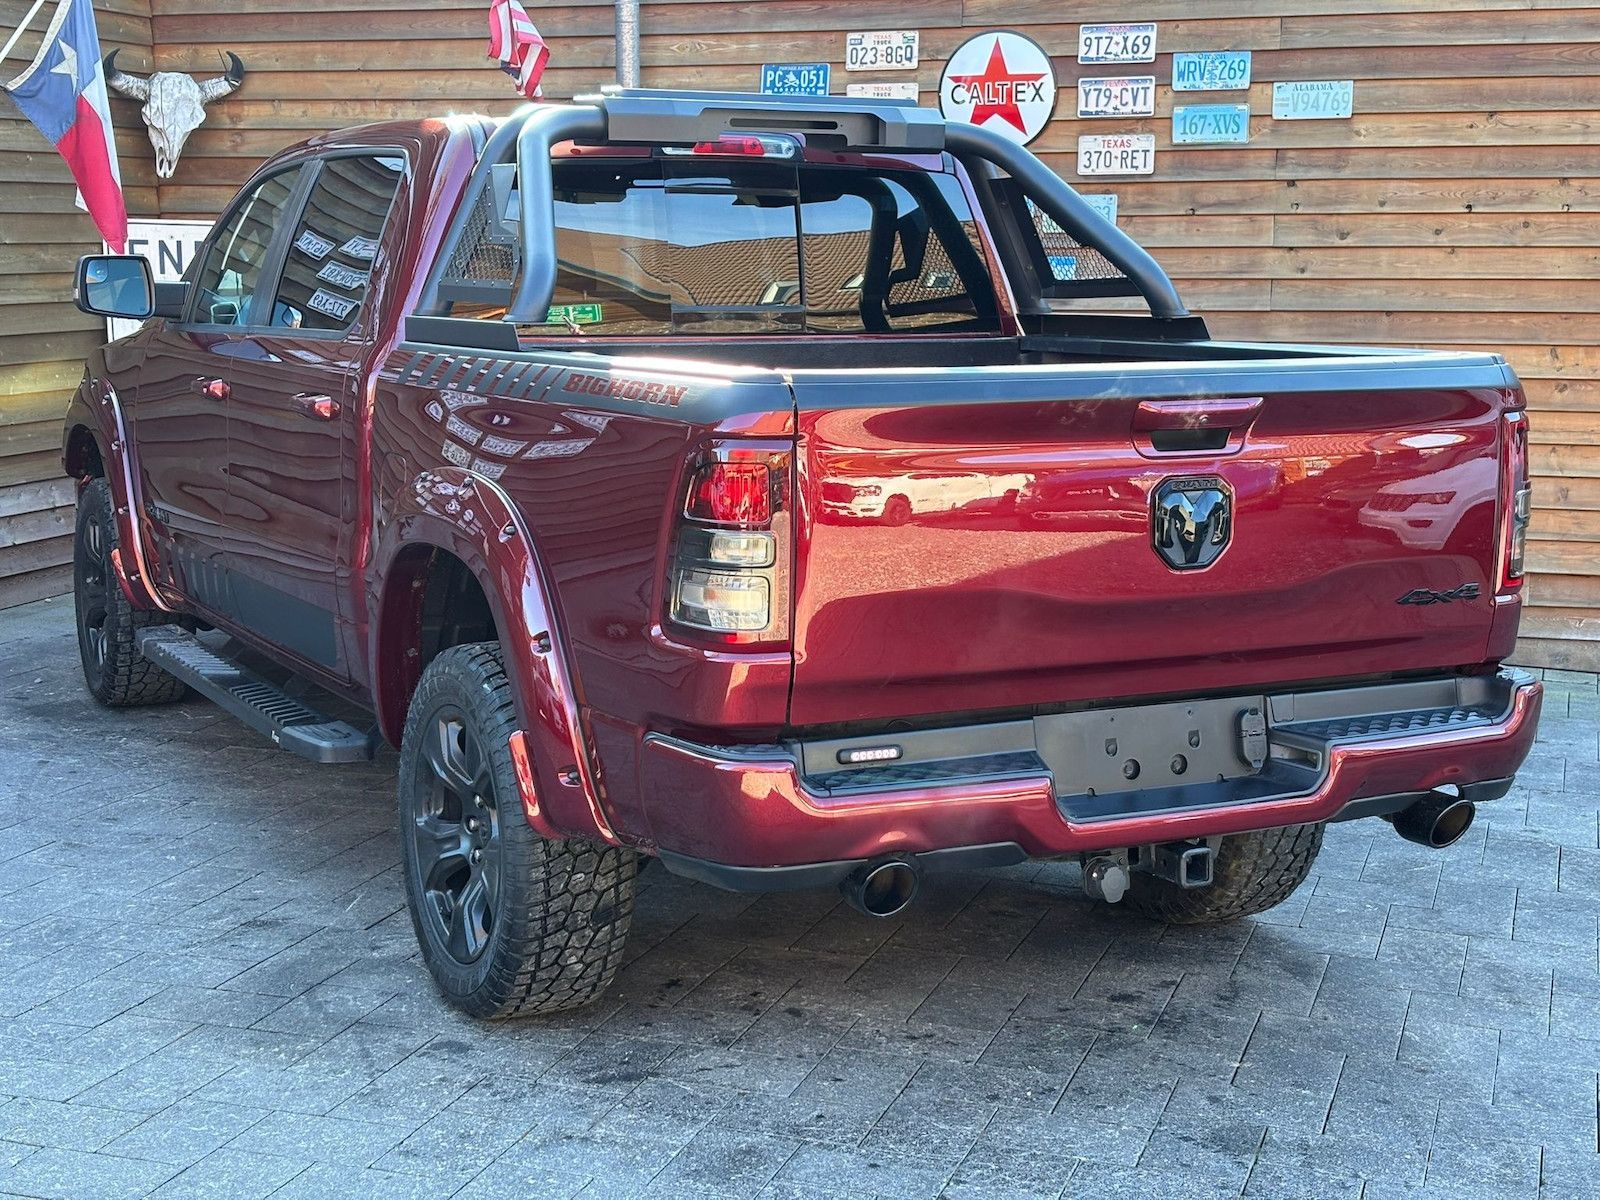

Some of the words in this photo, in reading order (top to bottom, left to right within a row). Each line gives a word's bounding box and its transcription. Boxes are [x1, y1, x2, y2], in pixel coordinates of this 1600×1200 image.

[766, 70, 783, 87] PC
[800, 70, 825, 87] 051
[1177, 60, 1207, 82] WRV
[1218, 59, 1247, 80] 269
[951, 81, 1045, 105] CALTEX
[1293, 82, 1334, 91] ALABAMA
[1291, 91, 1350, 113] V94769
[1101, 139, 1132, 149] TEXAS
[561, 373, 688, 407] BIGHORN
